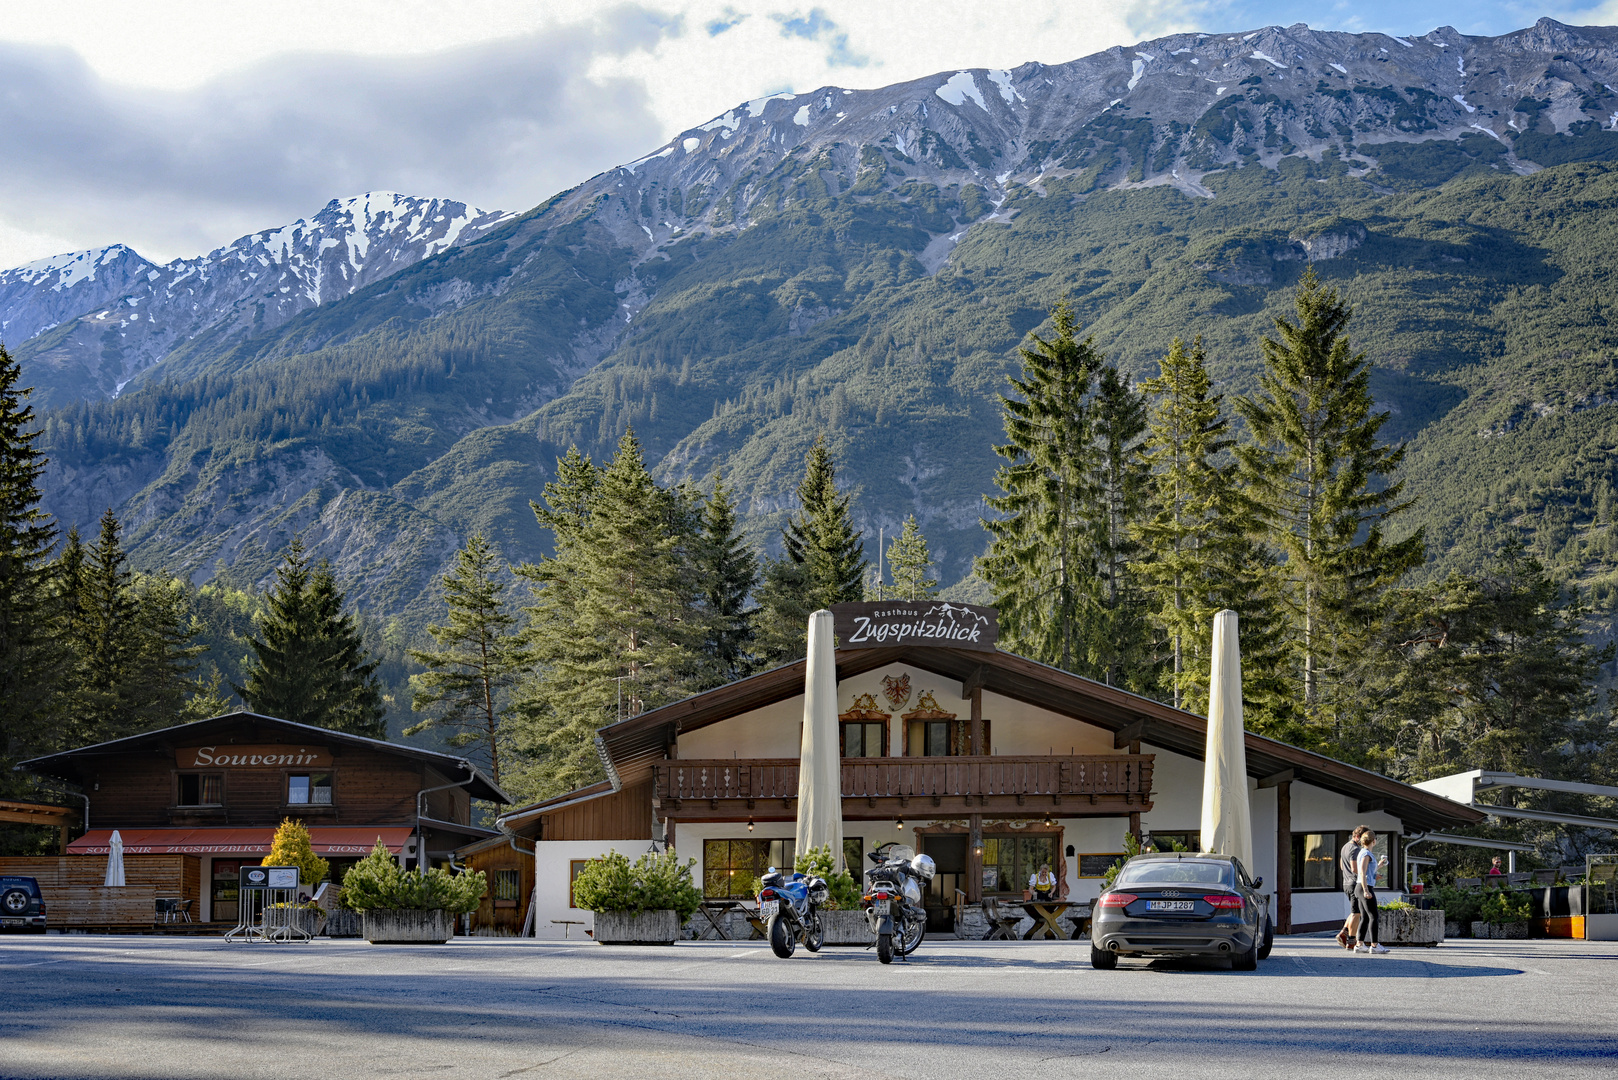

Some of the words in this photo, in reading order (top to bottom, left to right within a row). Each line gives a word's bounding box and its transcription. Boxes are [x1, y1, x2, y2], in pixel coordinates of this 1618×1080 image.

[874, 608, 918, 618] Rasthaus
[849, 616, 981, 643] Zugspitzblick
[194, 746, 317, 766] Souvenir
[166, 845, 265, 853] ZUGSPITZBLICK
[327, 845, 367, 853] KIOSK
[1150, 901, 1157, 909] M
[1161, 901, 1174, 909] JP
[1174, 901, 1194, 909] 1287
